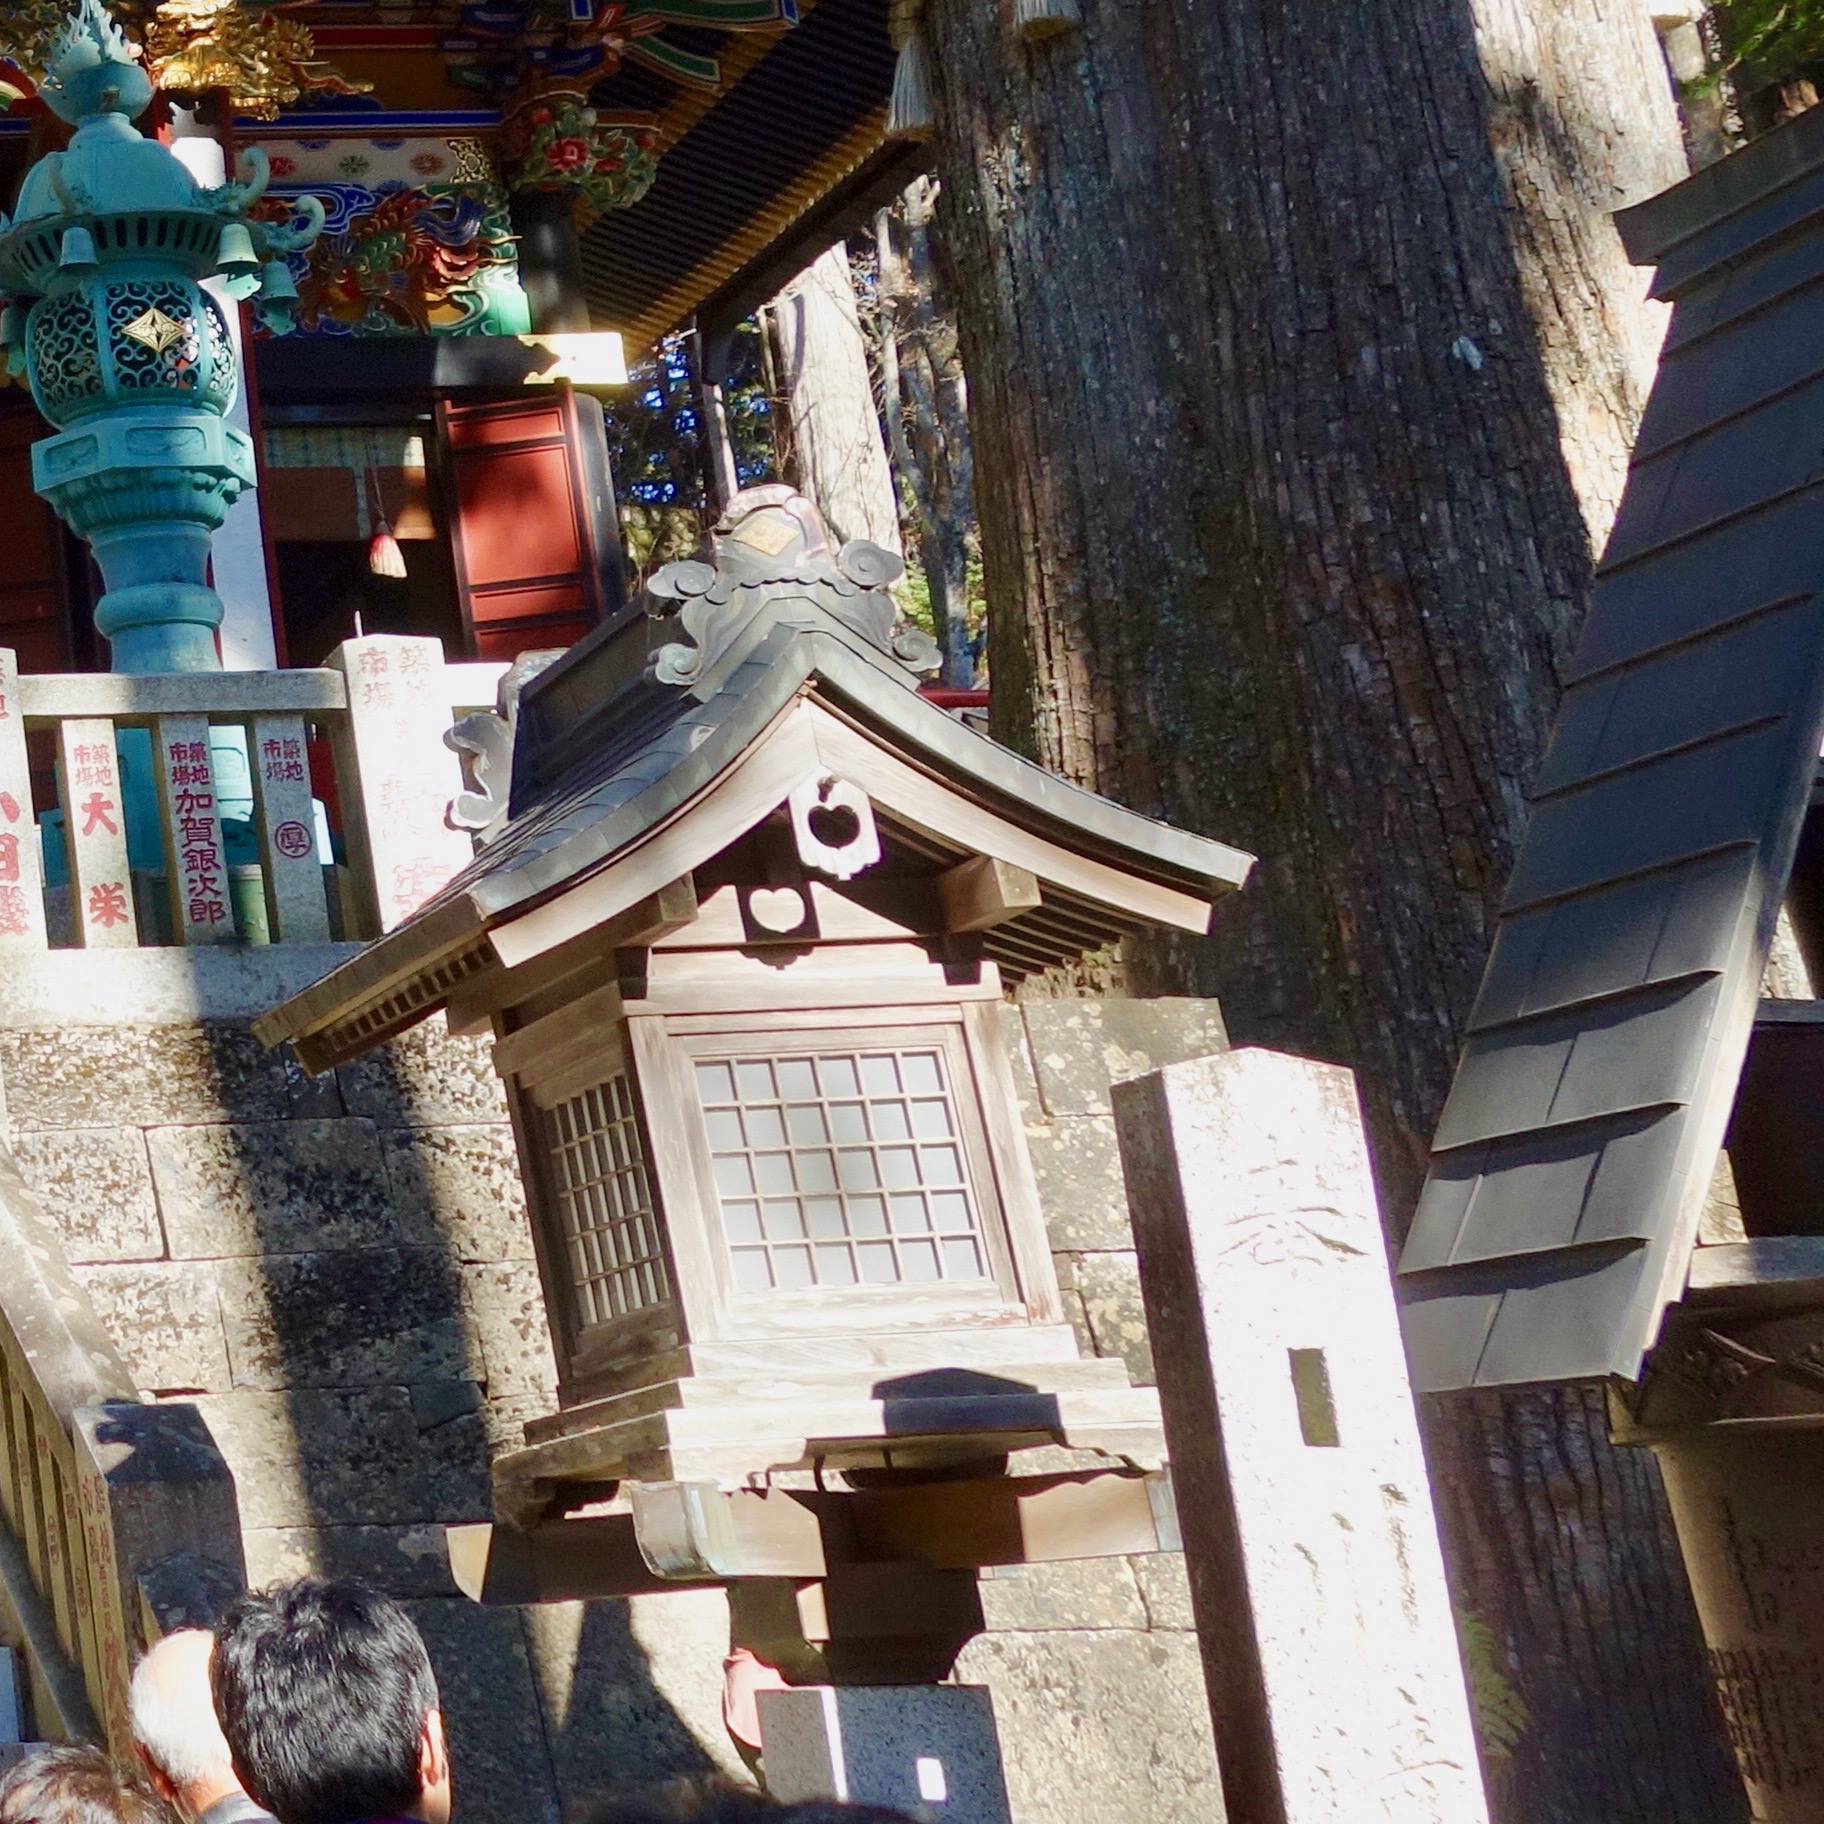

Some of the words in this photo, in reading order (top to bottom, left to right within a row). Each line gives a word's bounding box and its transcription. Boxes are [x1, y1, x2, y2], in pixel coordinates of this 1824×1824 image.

[81, 792, 129, 928] 大栄
[174, 787, 227, 925] 加賀銀次郎
